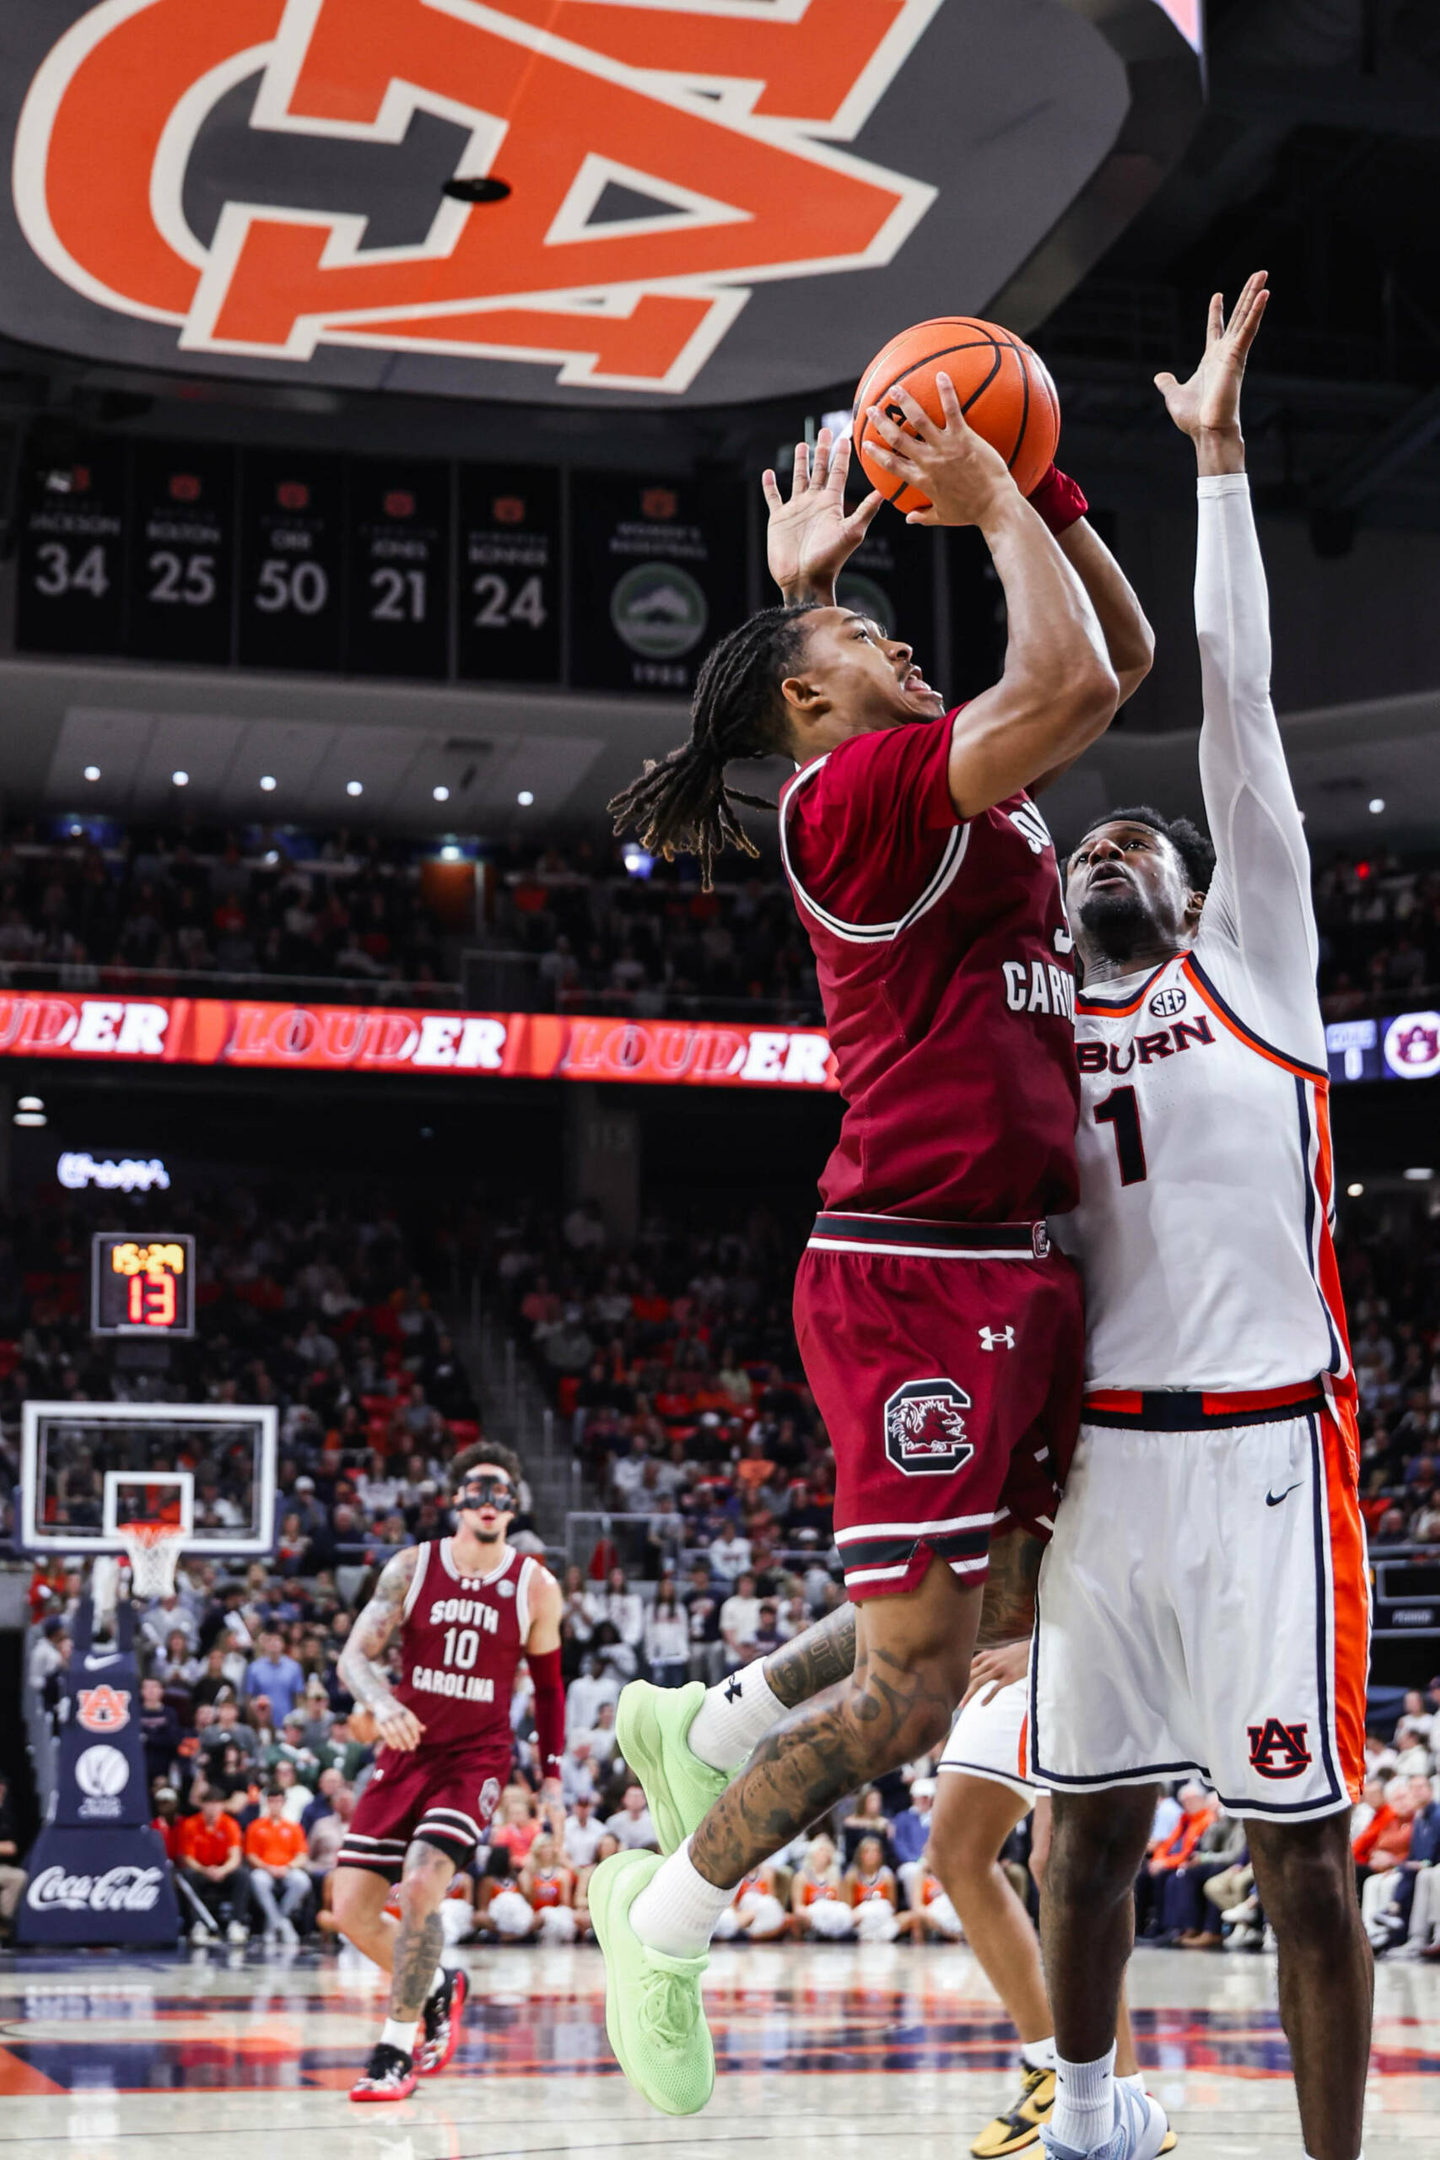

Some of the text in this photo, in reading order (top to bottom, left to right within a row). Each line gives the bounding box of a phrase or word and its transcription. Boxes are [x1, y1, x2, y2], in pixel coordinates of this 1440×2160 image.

[35, 543, 108, 597] 34
[148, 551, 216, 606] 25
[255, 559, 328, 614] 50
[370, 567, 427, 623] 21
[473, 572, 548, 628] 24
[1150, 988, 1185, 1017] SEC
[223, 1007, 507, 1068] LOUDER
[562, 1023, 830, 1084] LOUDER
[1075, 1015, 1216, 1075] BURN
[1093, 1084, 1147, 1187] 1
[128, 1273, 177, 1326] 13
[429, 1598, 499, 1635] SOUTH
[443, 1627, 480, 1670] 10
[412, 1665, 495, 1703] CAROLINA
